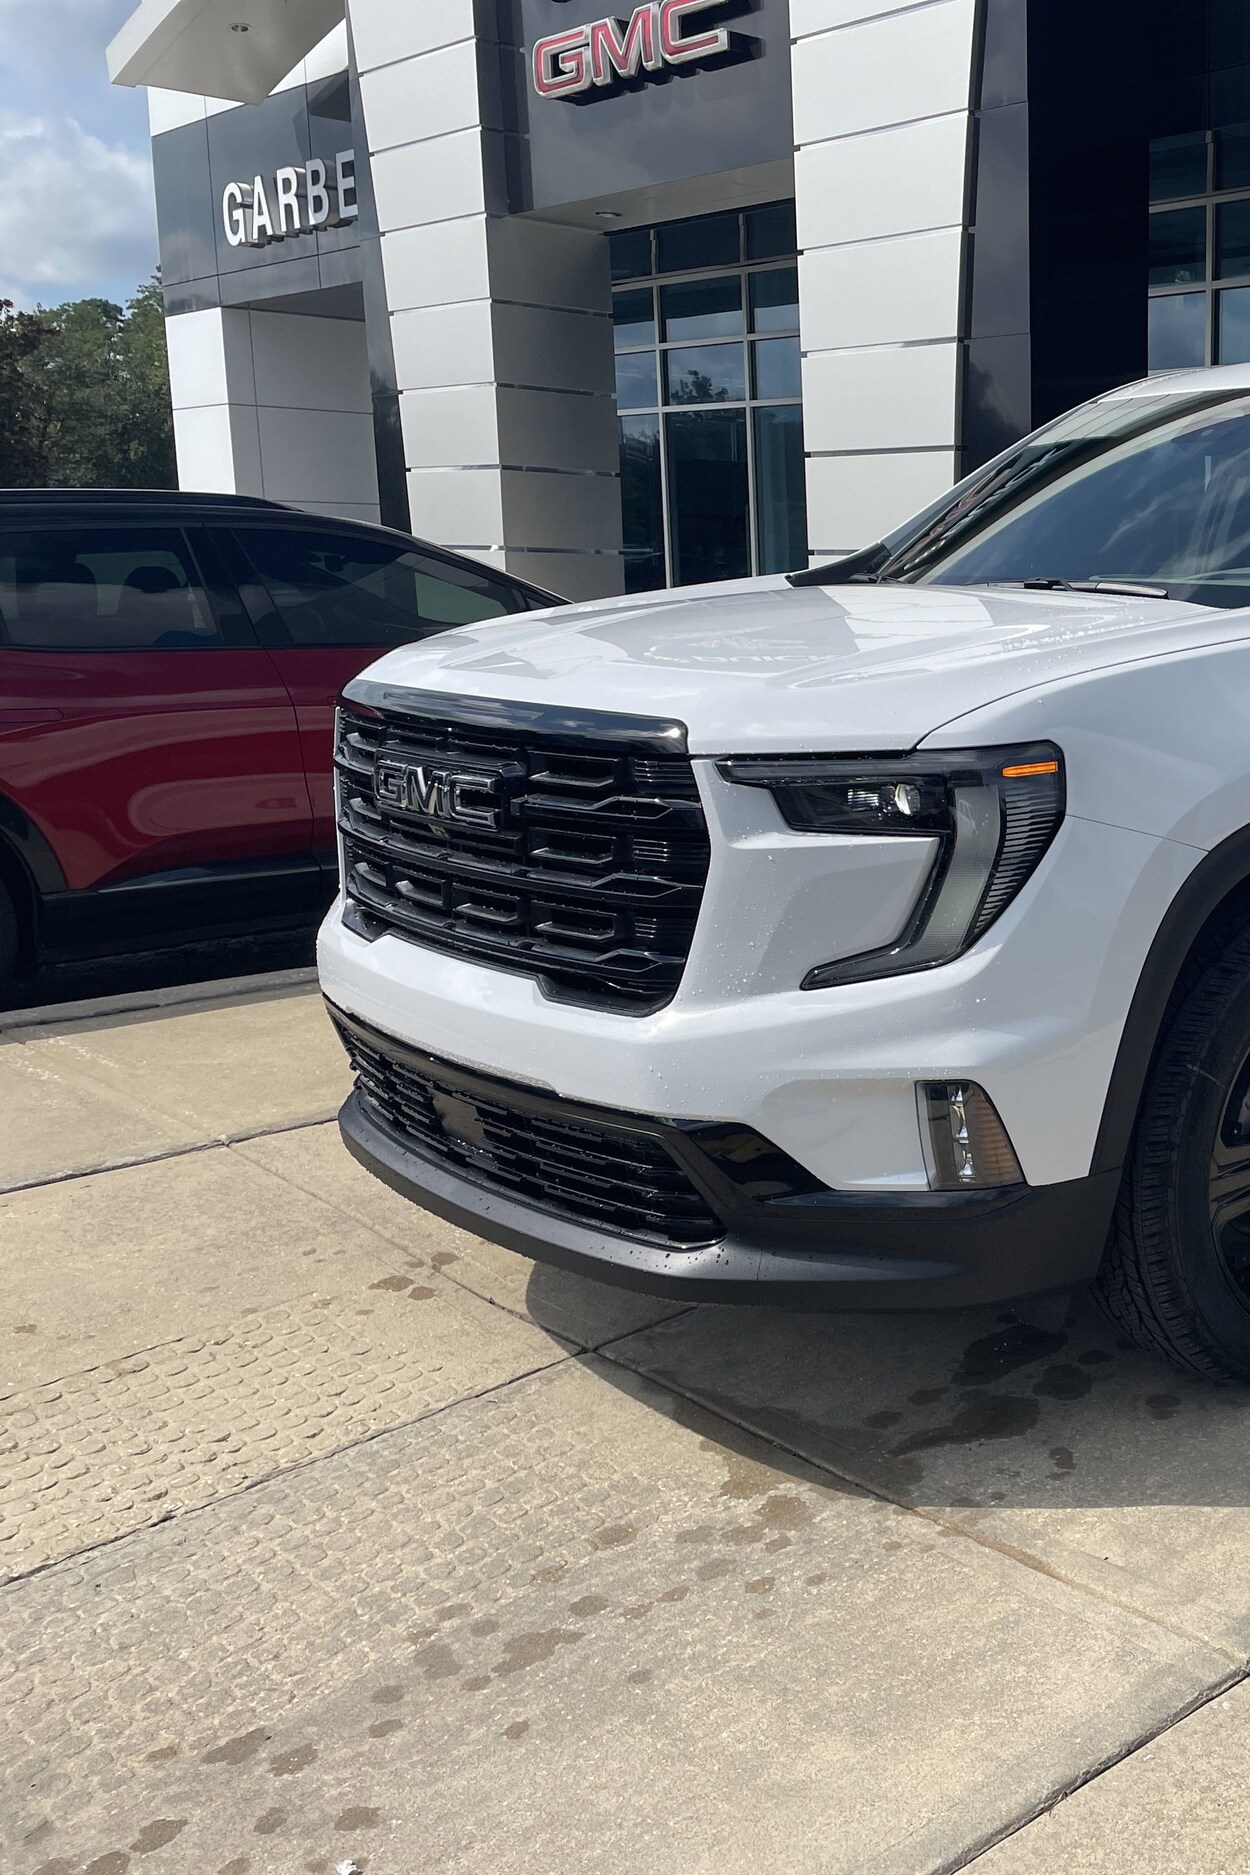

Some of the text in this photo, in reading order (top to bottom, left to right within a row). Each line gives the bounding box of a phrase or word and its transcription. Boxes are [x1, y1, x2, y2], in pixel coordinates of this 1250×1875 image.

[534, 0, 730, 98] GMC
[222, 149, 358, 246] GARBE
[375, 760, 501, 832] GMC
